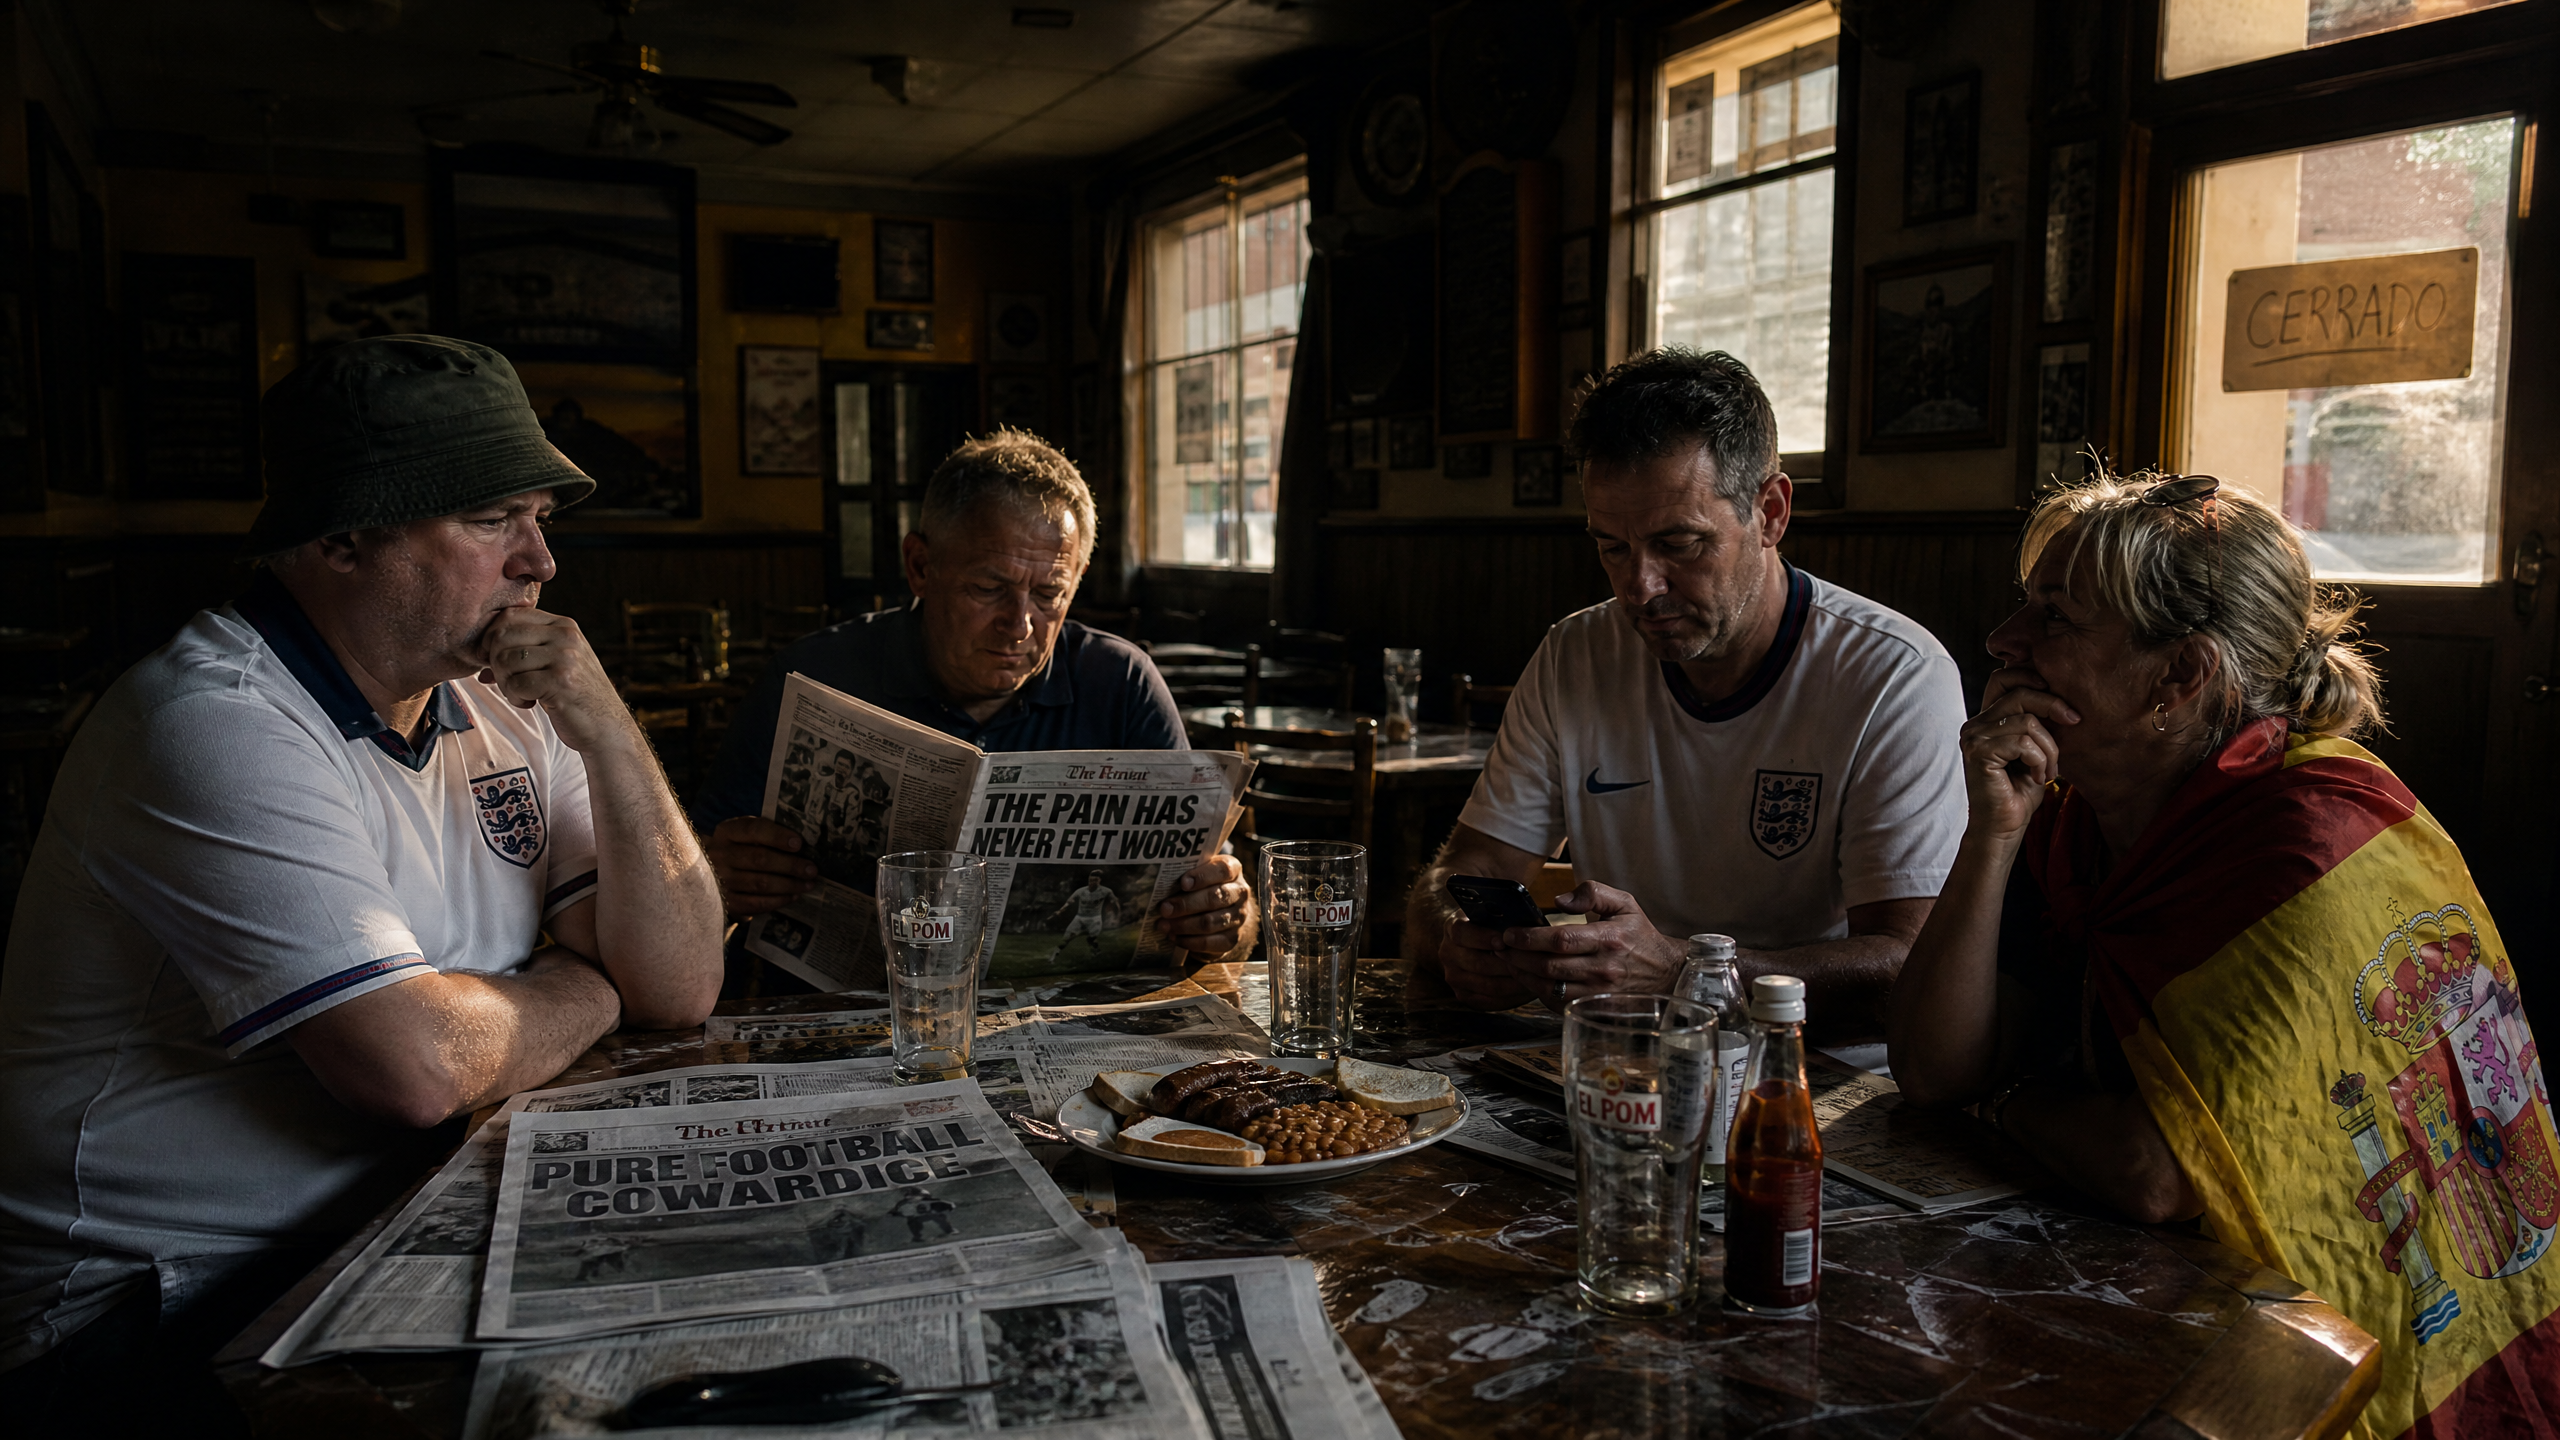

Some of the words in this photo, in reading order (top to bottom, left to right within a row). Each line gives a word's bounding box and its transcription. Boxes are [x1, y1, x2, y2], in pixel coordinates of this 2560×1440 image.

[2246, 282, 2447, 349] CERRADO
[984, 793, 1047, 823] THE
[1048, 793, 1130, 824] PAIN
[1132, 794, 1200, 825] HAS
[970, 827, 1055, 858] NEVER
[1056, 828, 1118, 859] FELT
[1119, 827, 1209, 859] WORSE
[893, 919, 908, 938] EL
[911, 922, 950, 939] POM
[1293, 906, 1310, 922] EL
[1315, 906, 1350, 923] POM
[1578, 1090, 1597, 1118] EL
[1601, 1097, 1656, 1126] POM
[675, 1124, 731, 1140] The
[531, 1153, 688, 1190] PURE
[698, 1122, 985, 1179] FOOTBALL
[566, 1152, 969, 1218] COWARDICE
